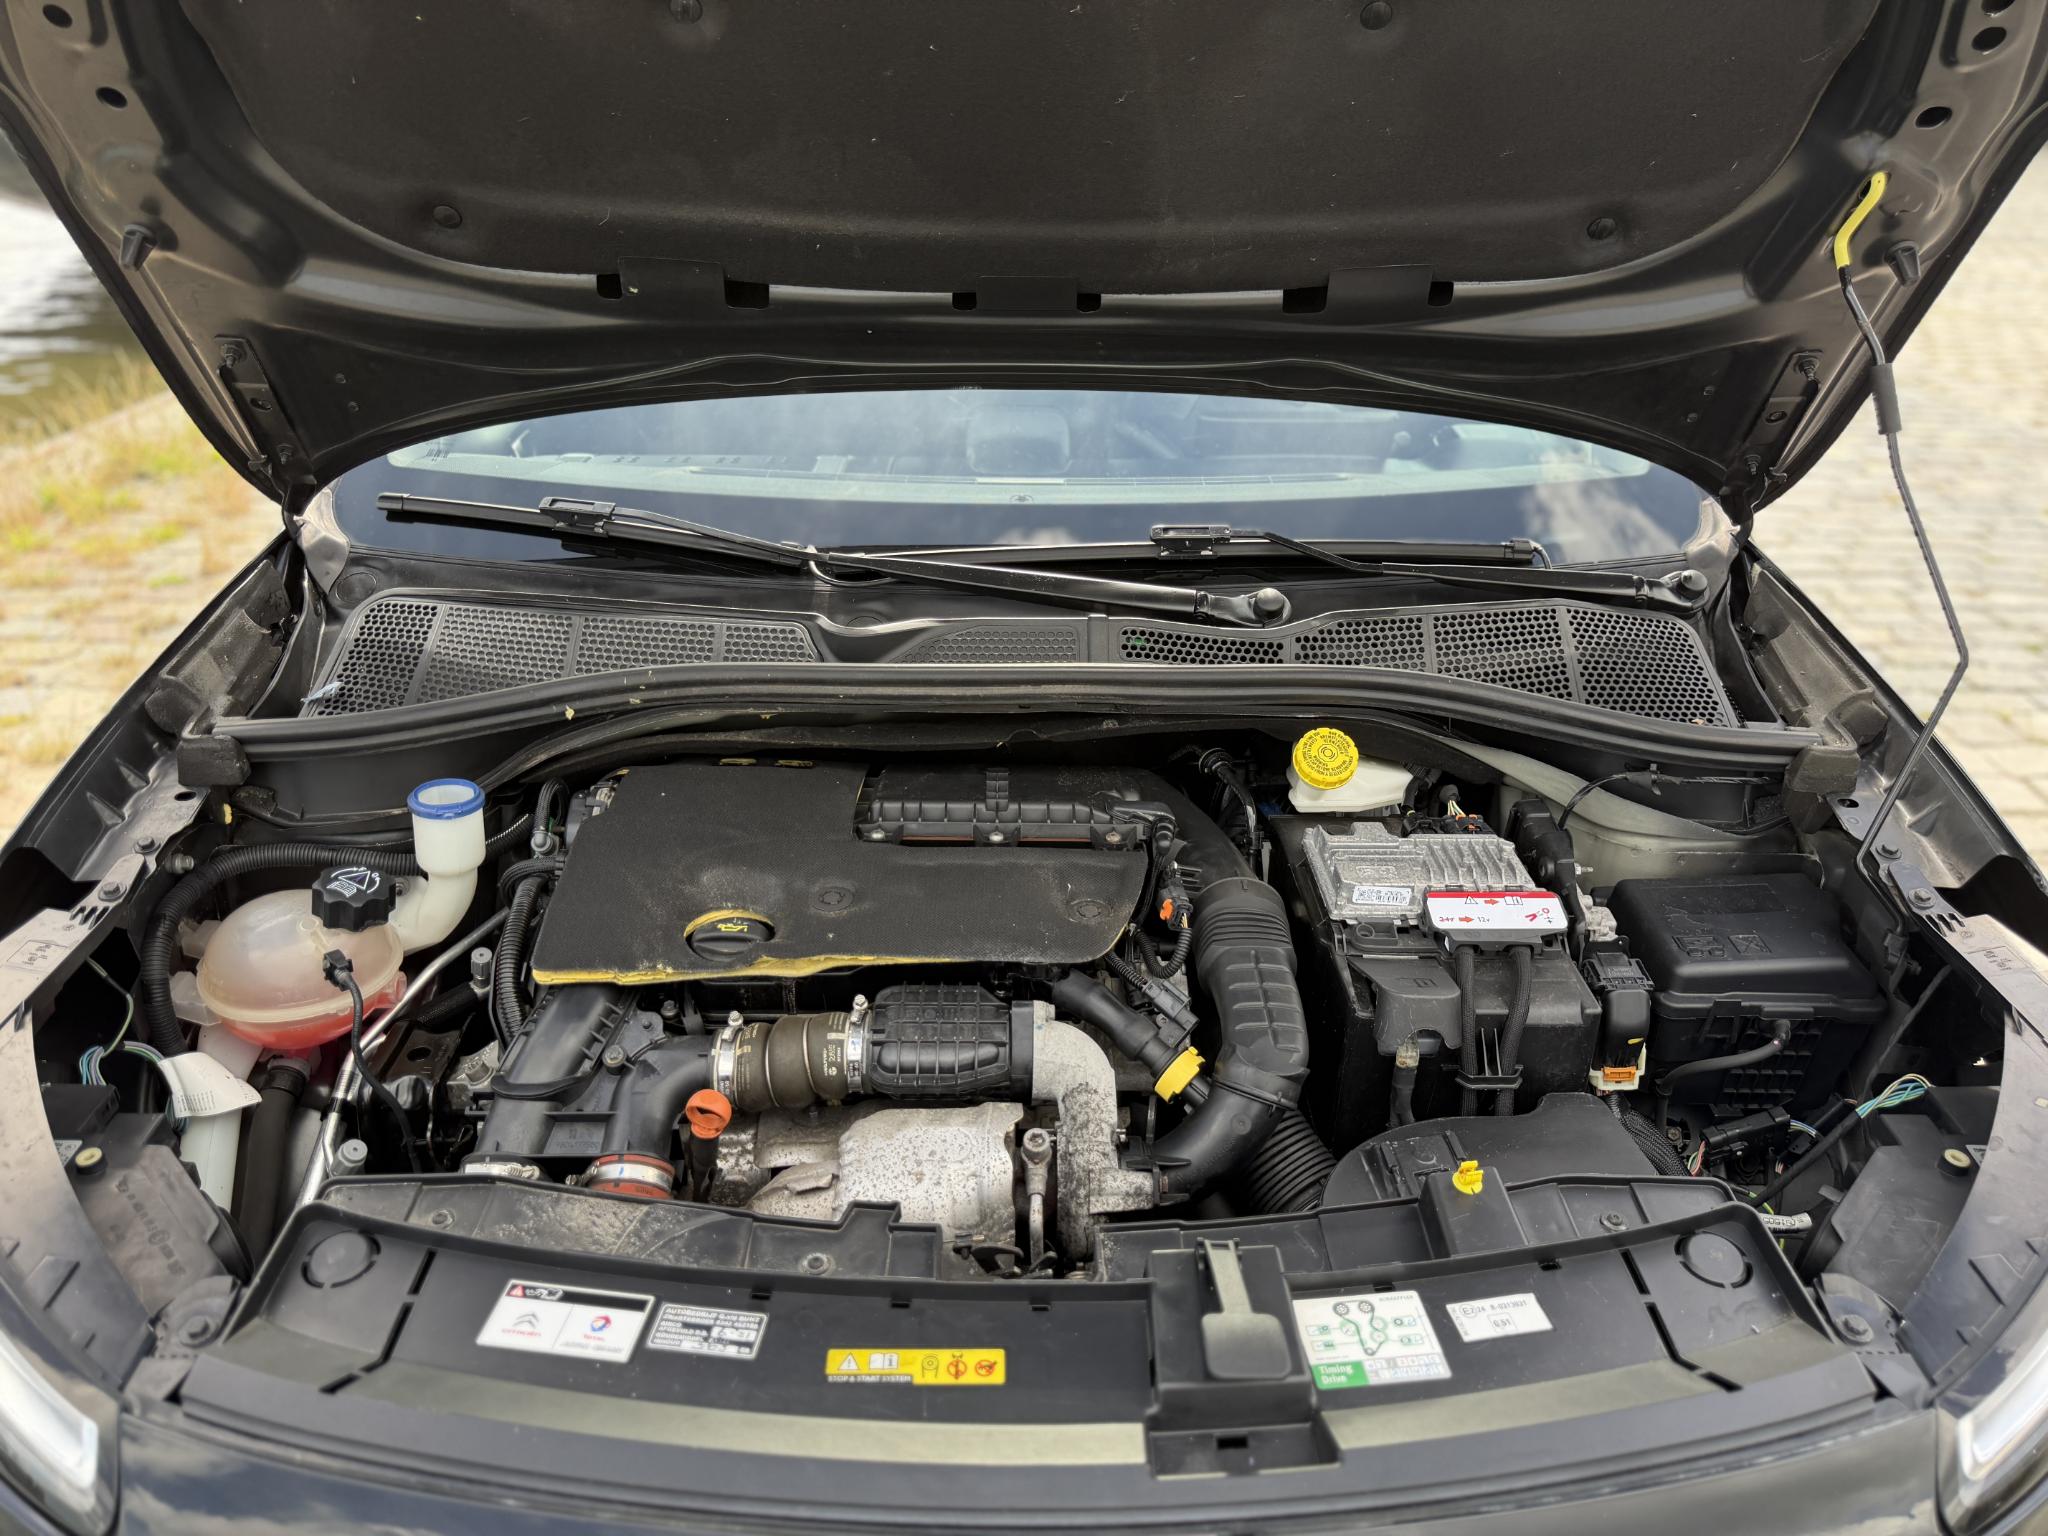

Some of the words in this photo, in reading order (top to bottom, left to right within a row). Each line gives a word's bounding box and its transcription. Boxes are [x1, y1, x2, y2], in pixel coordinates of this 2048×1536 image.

[1318, 1363, 1353, 1375] Timing
[827, 1375, 849, 1384] STOP
[856, 1375, 880, 1384] START
[881, 1375, 912, 1384] SYSTEM
[1320, 1373, 1347, 1384] Drive
